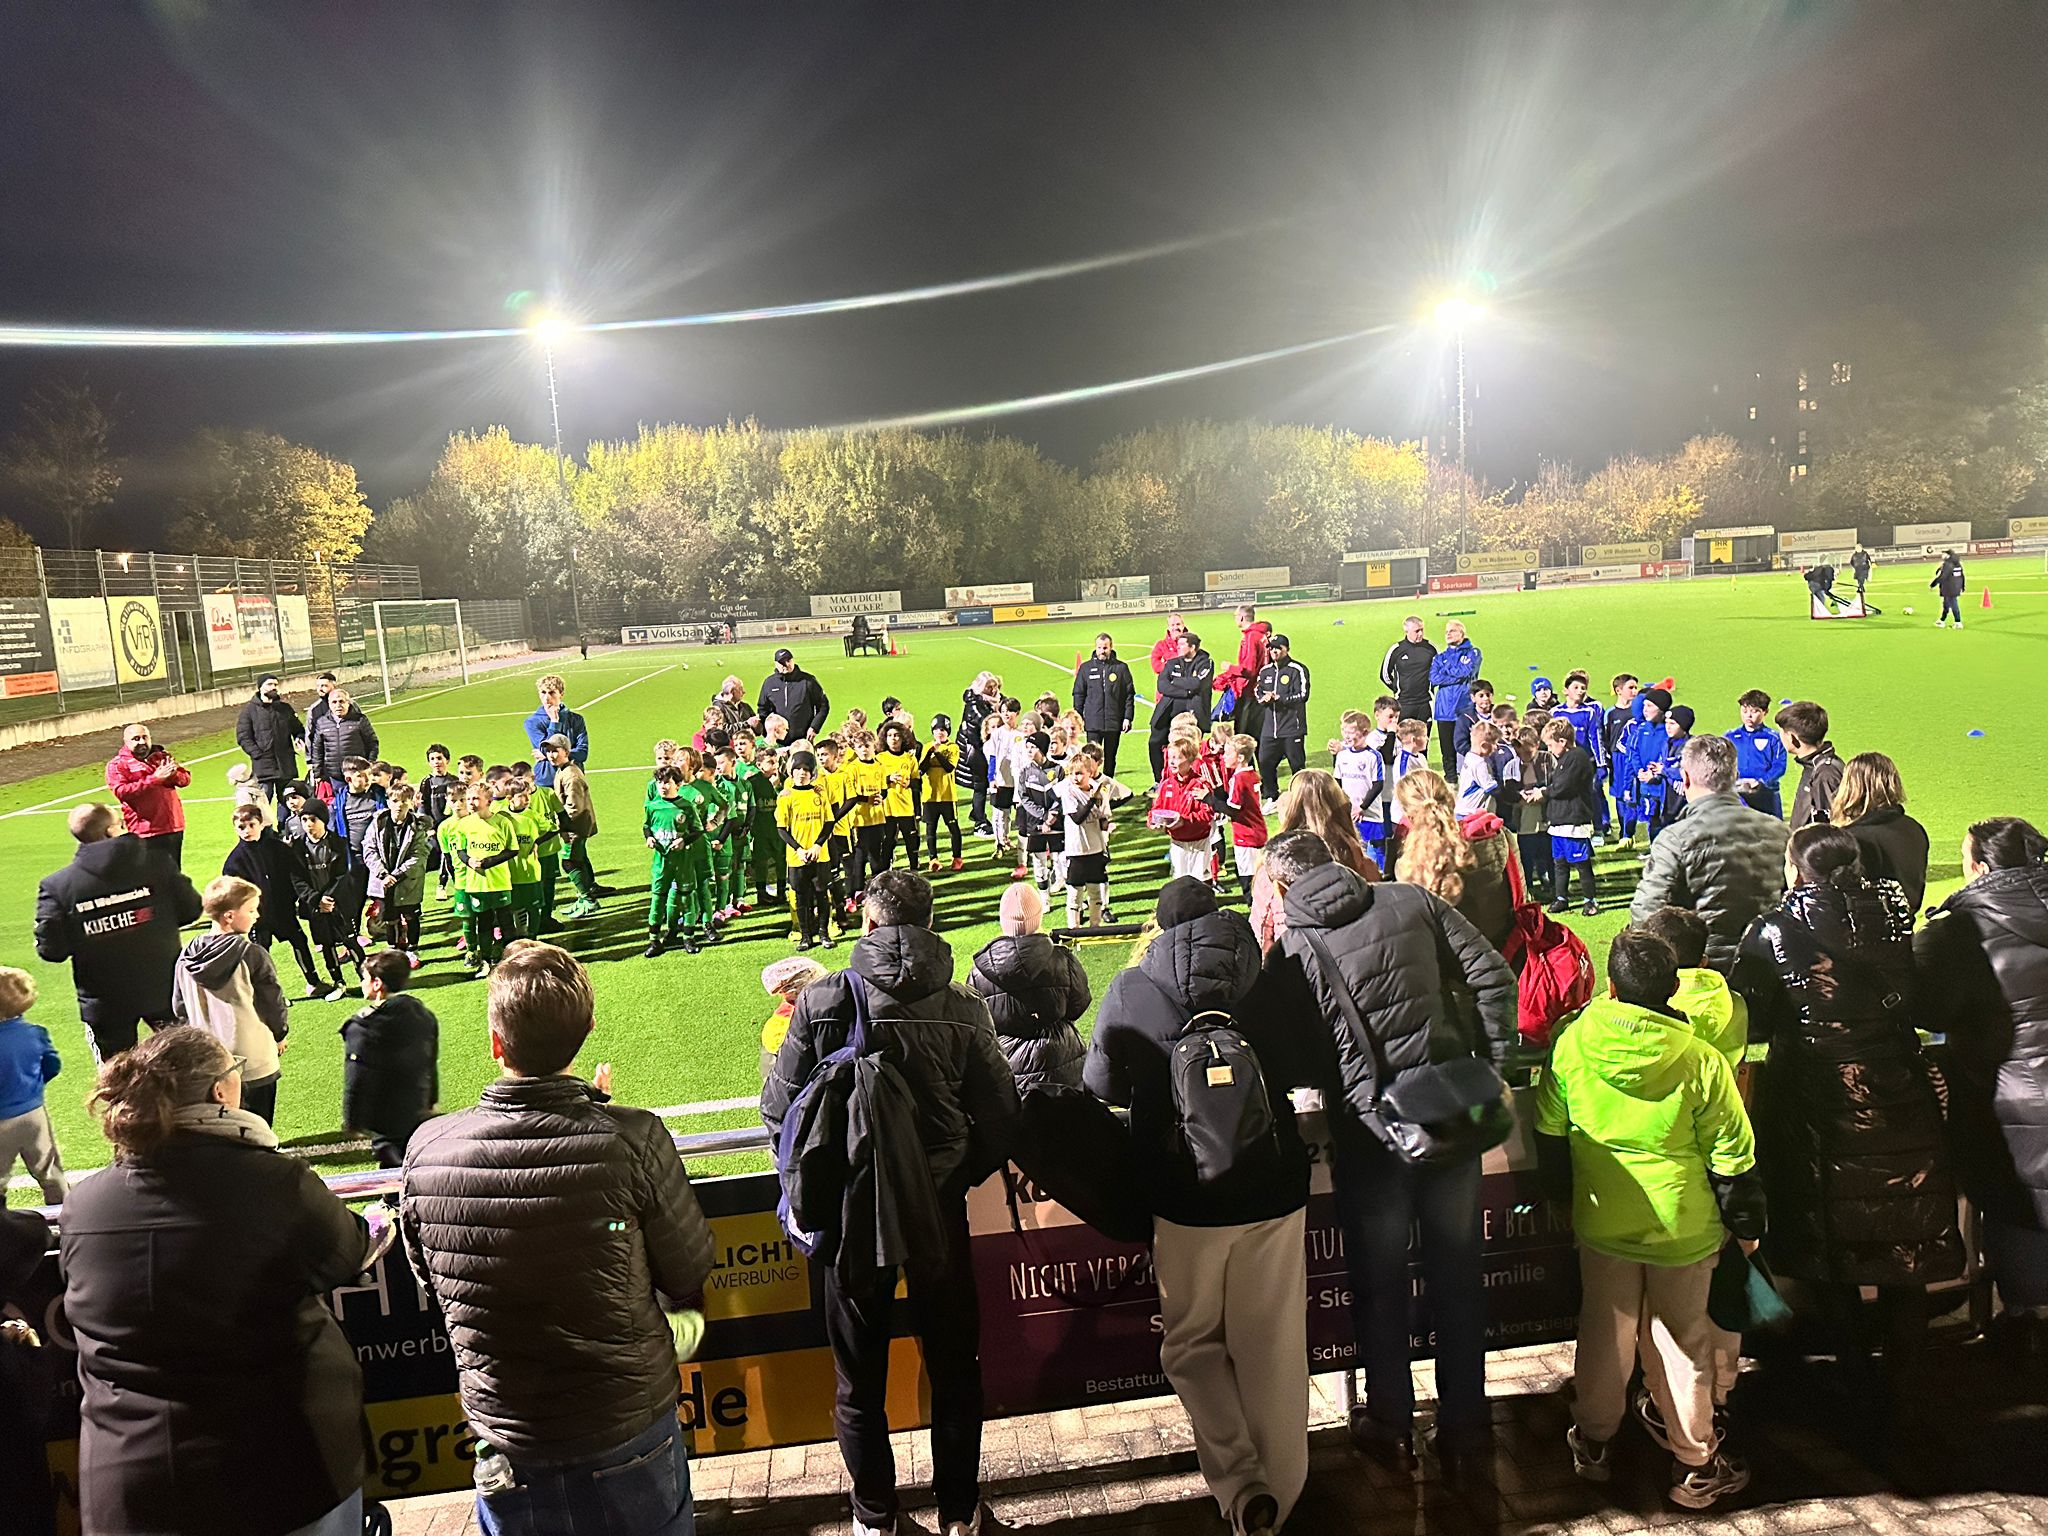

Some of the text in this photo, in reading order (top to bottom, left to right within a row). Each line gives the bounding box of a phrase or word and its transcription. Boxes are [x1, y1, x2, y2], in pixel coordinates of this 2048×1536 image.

[1442, 581, 1473, 590] Sparkasse
[719, 603, 748, 612] Gin der
[829, 593, 882, 605] MACH DICH
[829, 602, 884, 614] VOM ACKER!
[651, 626, 712, 640] Volksbank
[83, 910, 137, 936] KUECHE
[711, 1265, 801, 1290] WERBUNG
[1009, 1262, 1078, 1301] NICHT
[1482, 1263, 1546, 1288] amilie
[357, 1328, 448, 1362] nwerb
[1312, 1341, 1358, 1361] Schel
[379, 1420, 476, 1488] gra
